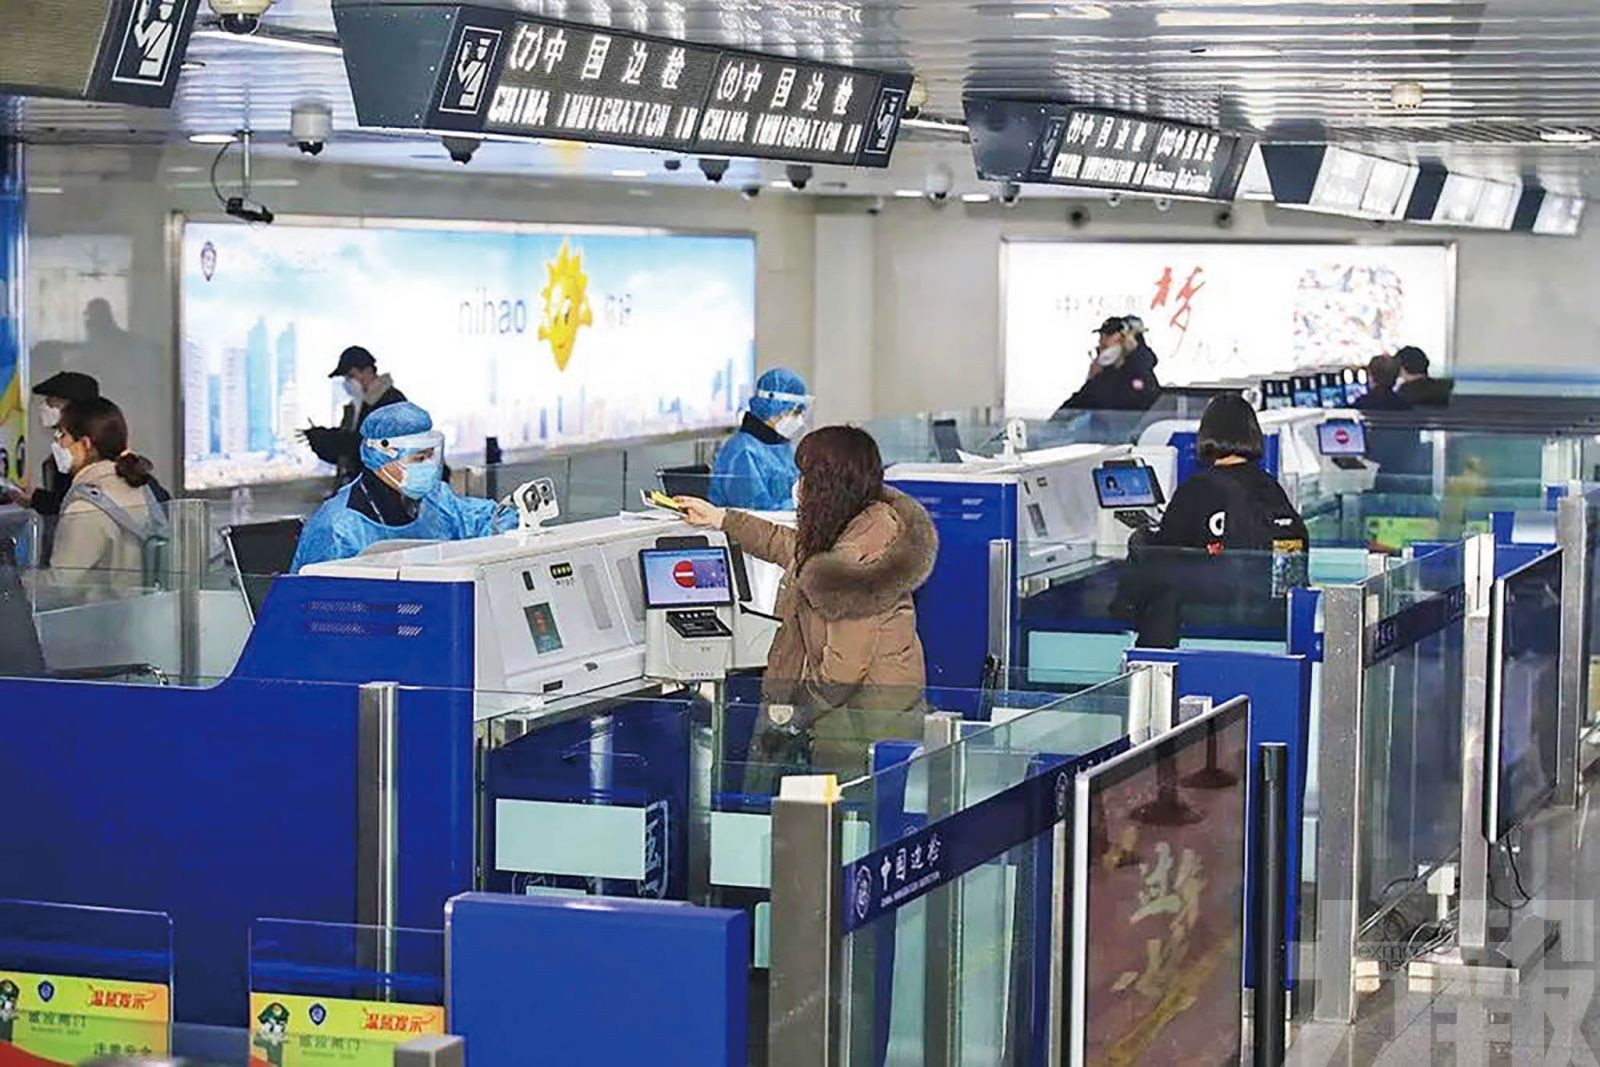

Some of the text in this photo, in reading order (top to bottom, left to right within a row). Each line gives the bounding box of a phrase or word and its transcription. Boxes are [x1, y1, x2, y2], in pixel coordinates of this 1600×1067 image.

[510, 25, 686, 89] (7)中国边检
[487, 85, 550, 126] CHINA
[557, 93, 672, 137] IMMIGRATION
[717, 60, 854, 115] (8)中国边检
[700, 108, 749, 143] CHINA
[752, 113, 844, 151] IMMIGRATION
[458, 286, 527, 335] nihao
